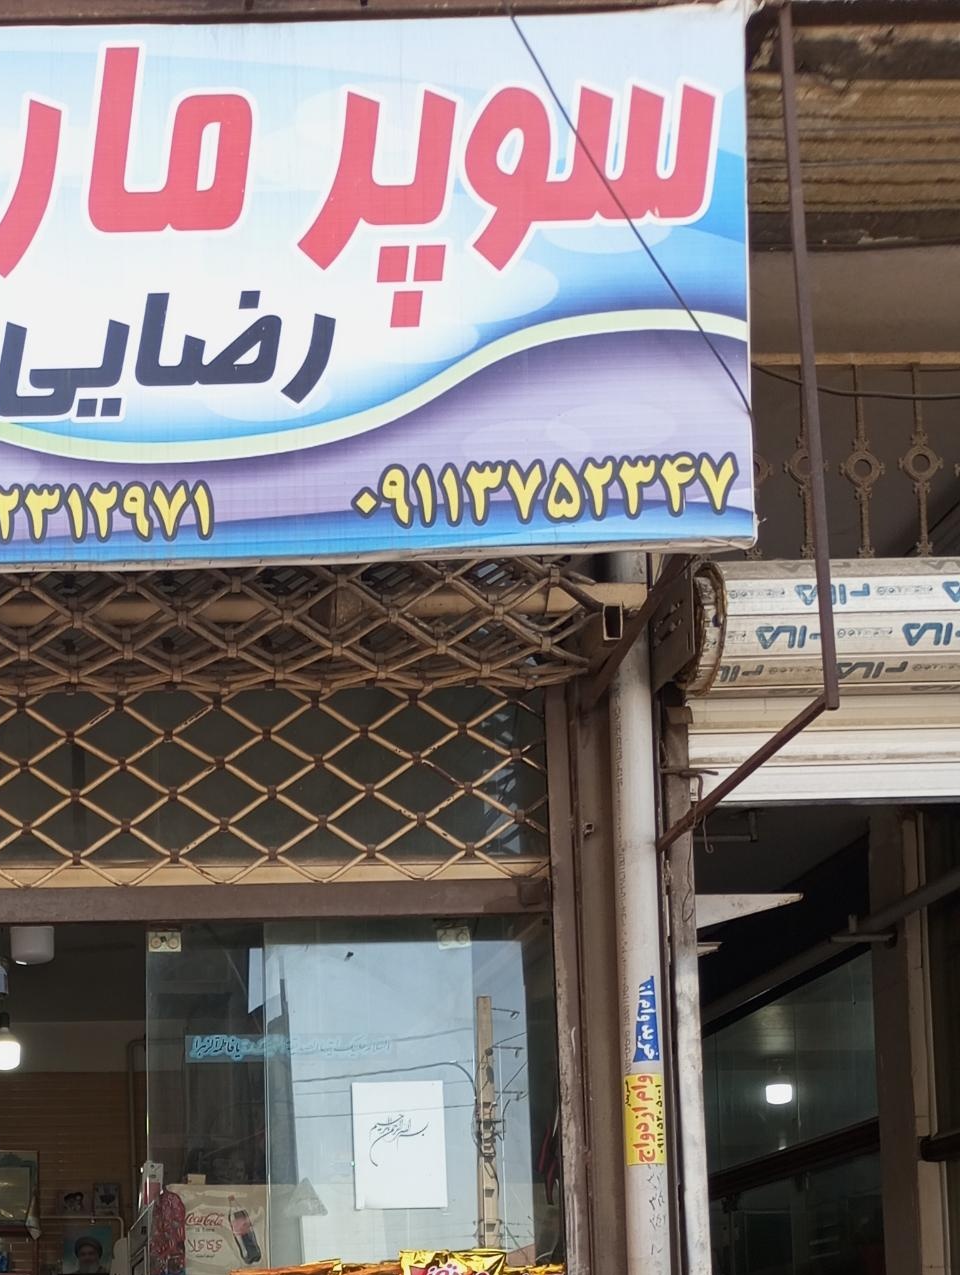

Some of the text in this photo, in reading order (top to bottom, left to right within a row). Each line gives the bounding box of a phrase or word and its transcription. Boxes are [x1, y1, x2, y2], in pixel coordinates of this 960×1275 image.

[298, 80, 718, 328] سوپر
[352, 451, 738, 529] ۰۹۱۱۳۷۵۲۳۴۷
[630, 1075, 656, 1163] وام ازدواج
